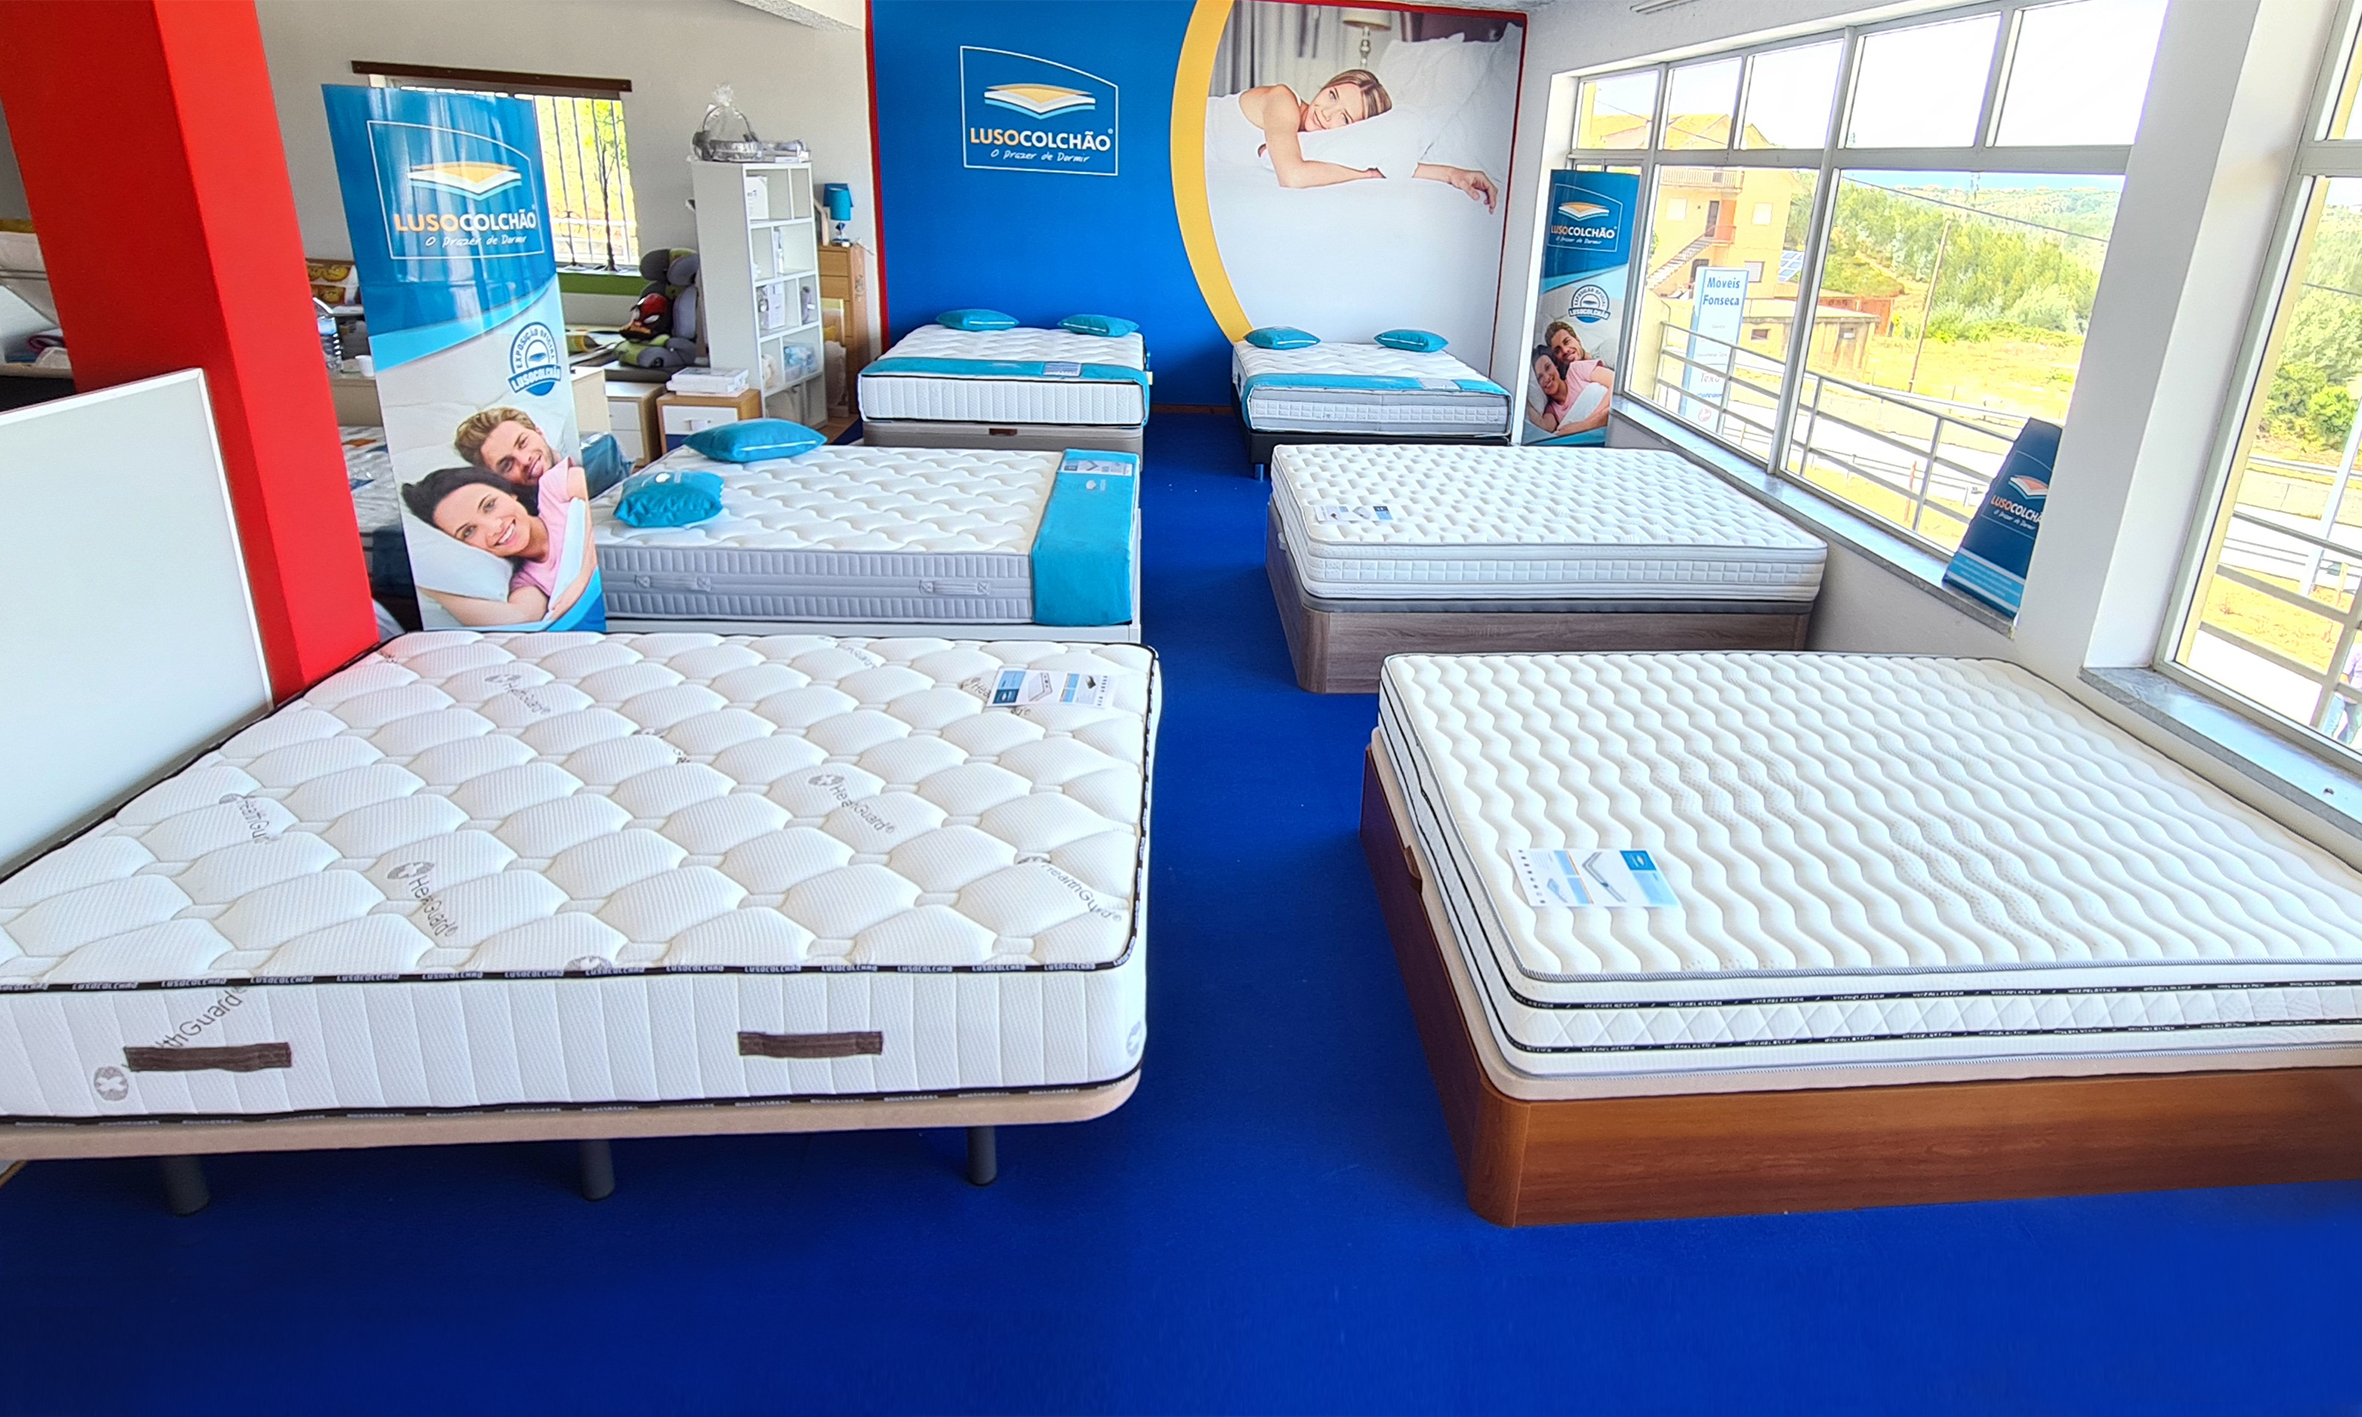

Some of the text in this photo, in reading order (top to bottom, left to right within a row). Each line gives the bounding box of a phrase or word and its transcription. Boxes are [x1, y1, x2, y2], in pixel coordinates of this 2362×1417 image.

[969, 127, 1111, 151] LUSOCOLCHÃO
[990, 149, 1000, 158] O
[1041, 151, 1053, 161] de
[1057, 152, 1090, 163] Dormir
[393, 208, 537, 232] LUSOCOLCHÃO
[1550, 225, 1616, 239] LUSOCOLCHÃO
[425, 236, 437, 247] O
[486, 235, 498, 245] de
[1702, 294, 1740, 306] Fonseca
